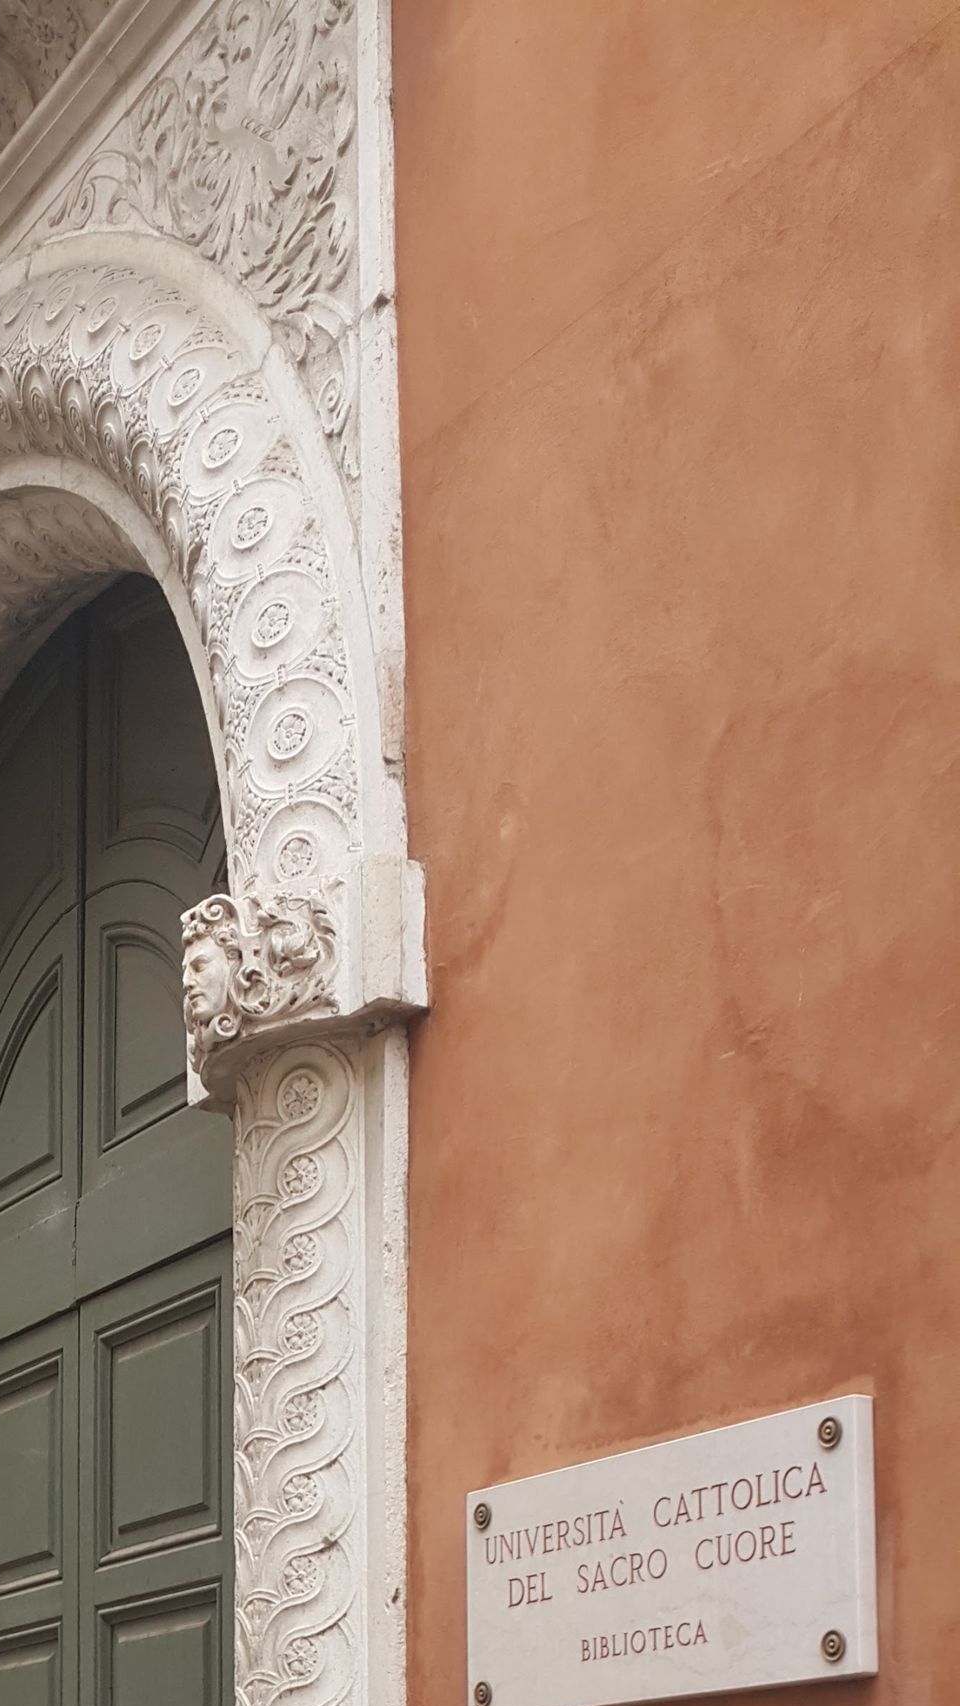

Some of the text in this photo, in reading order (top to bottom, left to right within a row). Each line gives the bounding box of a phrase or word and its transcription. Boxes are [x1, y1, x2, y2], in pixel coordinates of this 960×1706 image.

[485, 1462, 827, 1564] UNIVERSITÀ CATTOLICA
[508, 1521, 797, 1608] DEL SACRO CUORE
[581, 1620, 708, 1662] BIBLIOTECA
